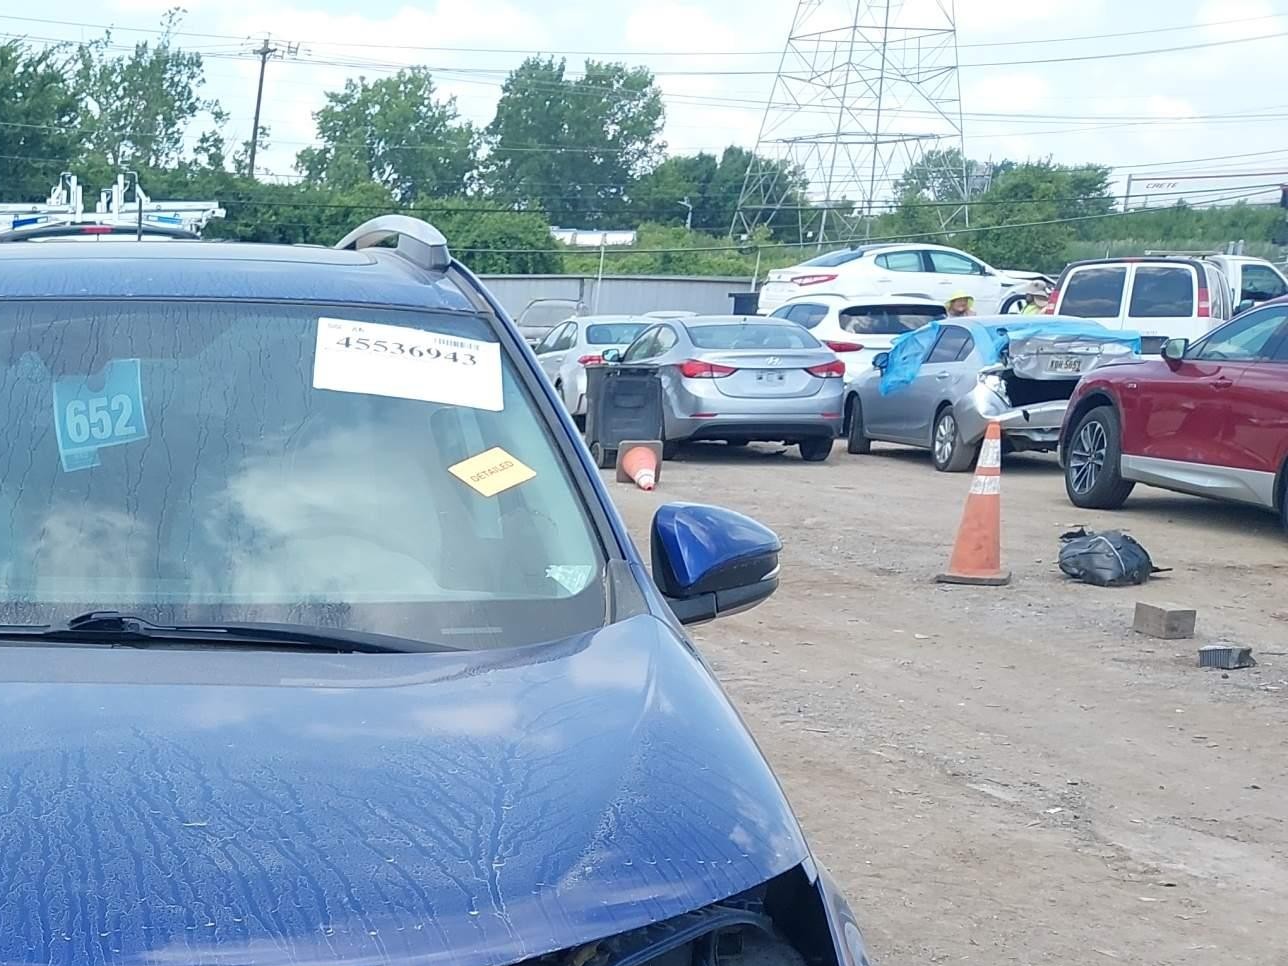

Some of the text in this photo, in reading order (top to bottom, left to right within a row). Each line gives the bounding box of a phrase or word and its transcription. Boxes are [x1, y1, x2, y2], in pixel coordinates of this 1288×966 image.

[336, 336, 478, 366] 45536943
[66, 394, 137, 444] 652
[470, 460, 514, 482] DETAILED
